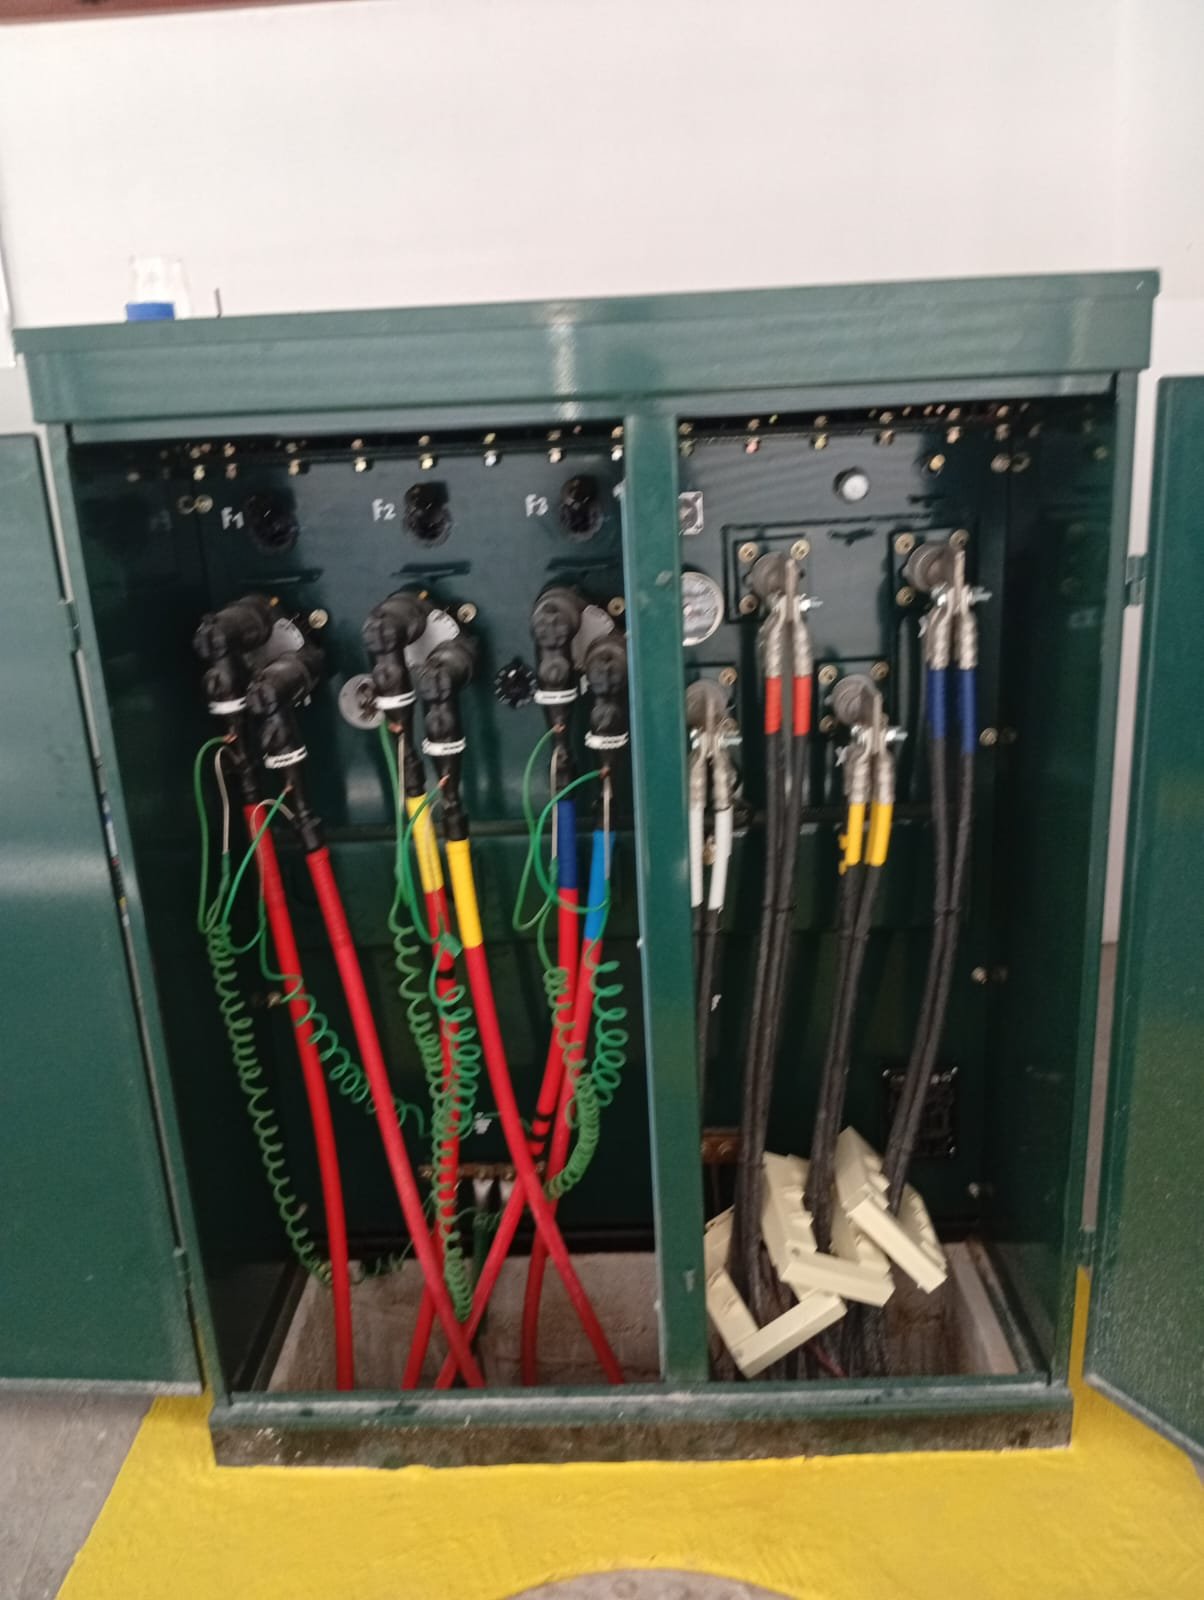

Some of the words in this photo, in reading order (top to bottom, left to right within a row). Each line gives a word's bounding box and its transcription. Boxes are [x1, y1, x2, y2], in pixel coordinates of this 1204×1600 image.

[371, 498, 397, 522] F2
[525, 493, 549, 518] F3
[221, 506, 245, 530] F1
